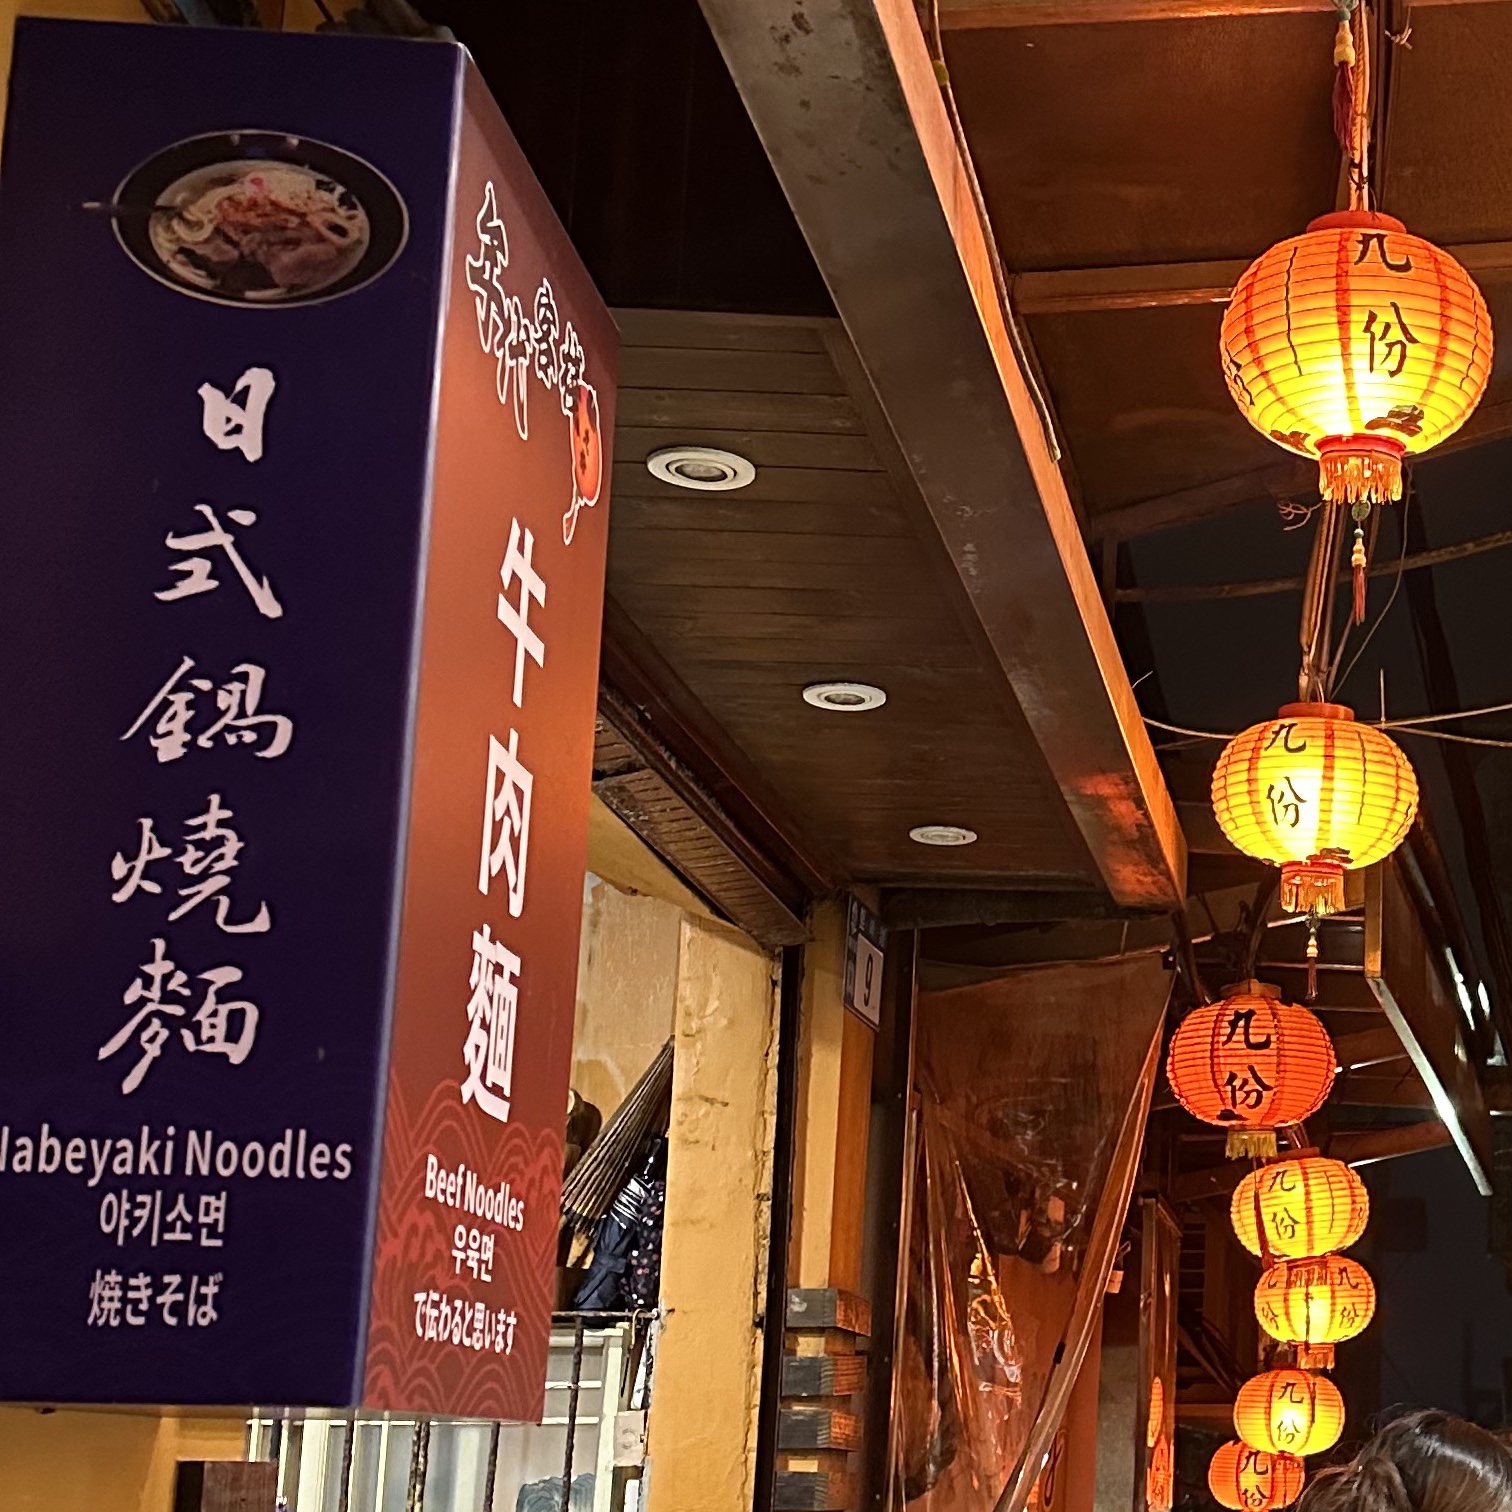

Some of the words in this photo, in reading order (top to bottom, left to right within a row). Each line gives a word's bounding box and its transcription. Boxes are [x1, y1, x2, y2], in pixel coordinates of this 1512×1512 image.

[1353, 232, 1420, 378] 九份
[99, 366, 294, 1094] 日式鍋燒麵
[1264, 722, 1307, 828] 九份
[461, 517, 546, 1123] 牛肉麵
[1222, 1008, 1275, 1110] 九份
[185, 1128, 353, 1180] Noodles
[99, 1188, 228, 1248] 야키소면
[424, 1153, 465, 1209] Beef
[464, 1170, 525, 1232] Noodles
[1268, 1169, 1301, 1241] 九份
[452, 1224, 495, 1283] 우육면
[86, 1268, 224, 1328] 焼きそば
[413, 1288, 518, 1356] で伝わると思います
[1278, 1381, 1304, 1445] 九份
[1240, 1451, 1269, 1508] 九份
